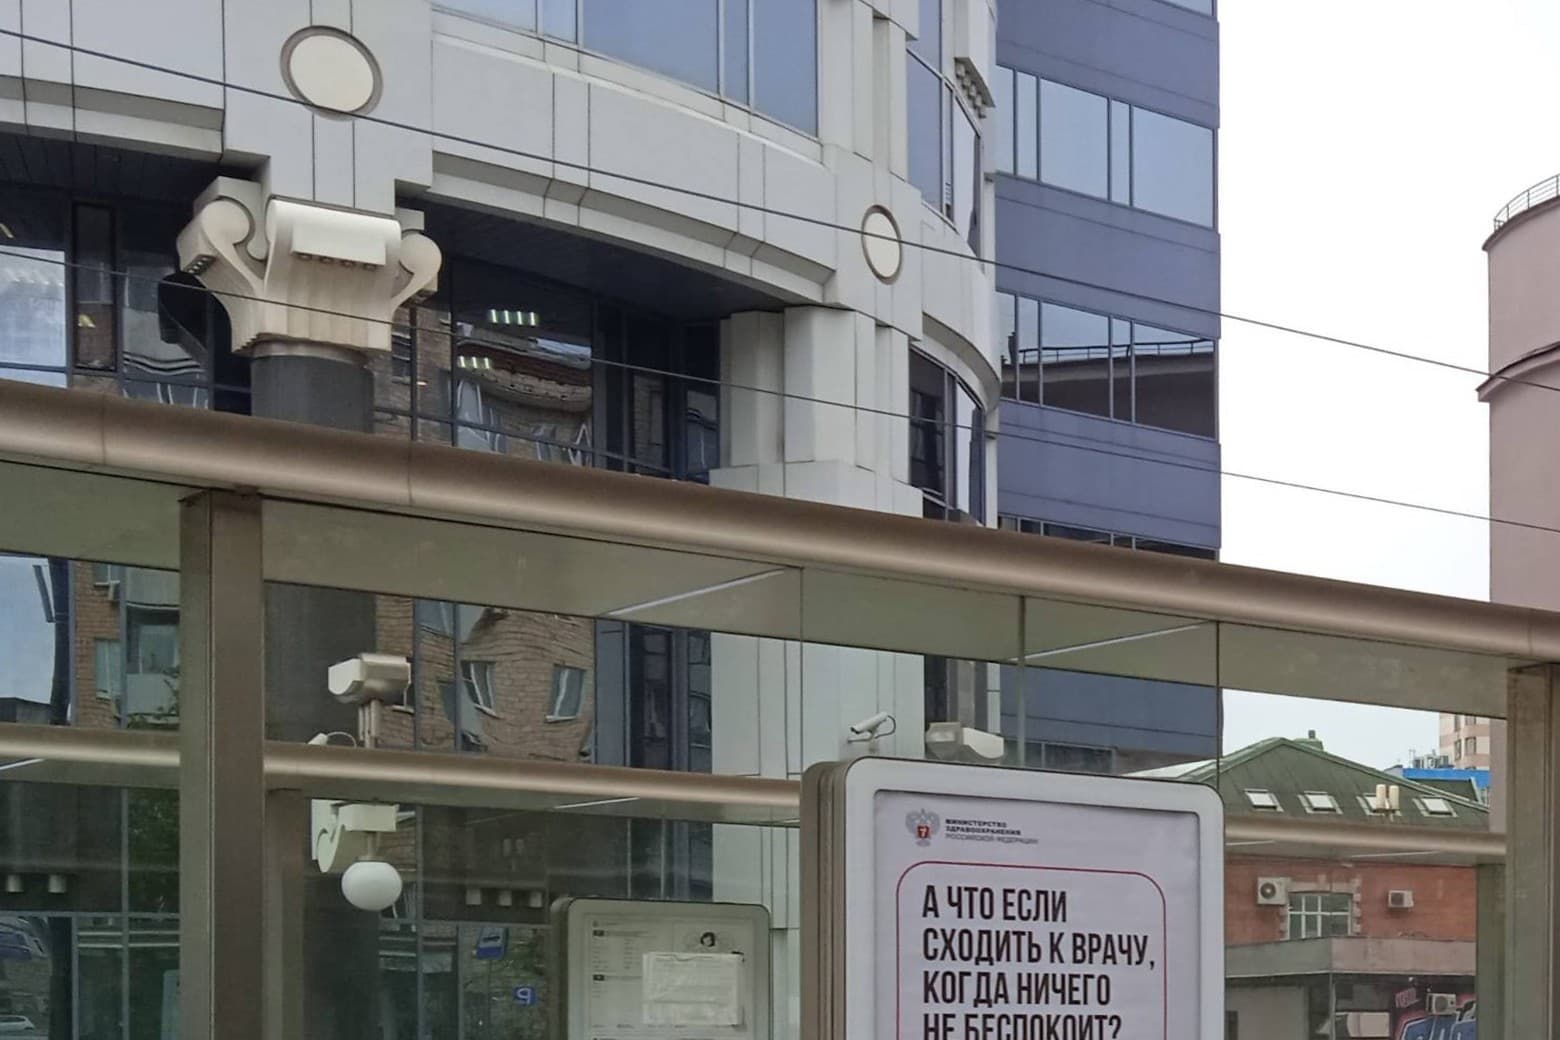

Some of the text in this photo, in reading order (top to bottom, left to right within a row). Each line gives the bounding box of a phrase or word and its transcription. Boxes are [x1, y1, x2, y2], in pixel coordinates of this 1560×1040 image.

[921, 884, 1067, 923] А ЧТО ЕСЛИ
[922, 927, 1155, 971] СХОДИТЬ К ВРАЧУ,
[923, 970, 1111, 1009] КОГДА НИЧЕГО
